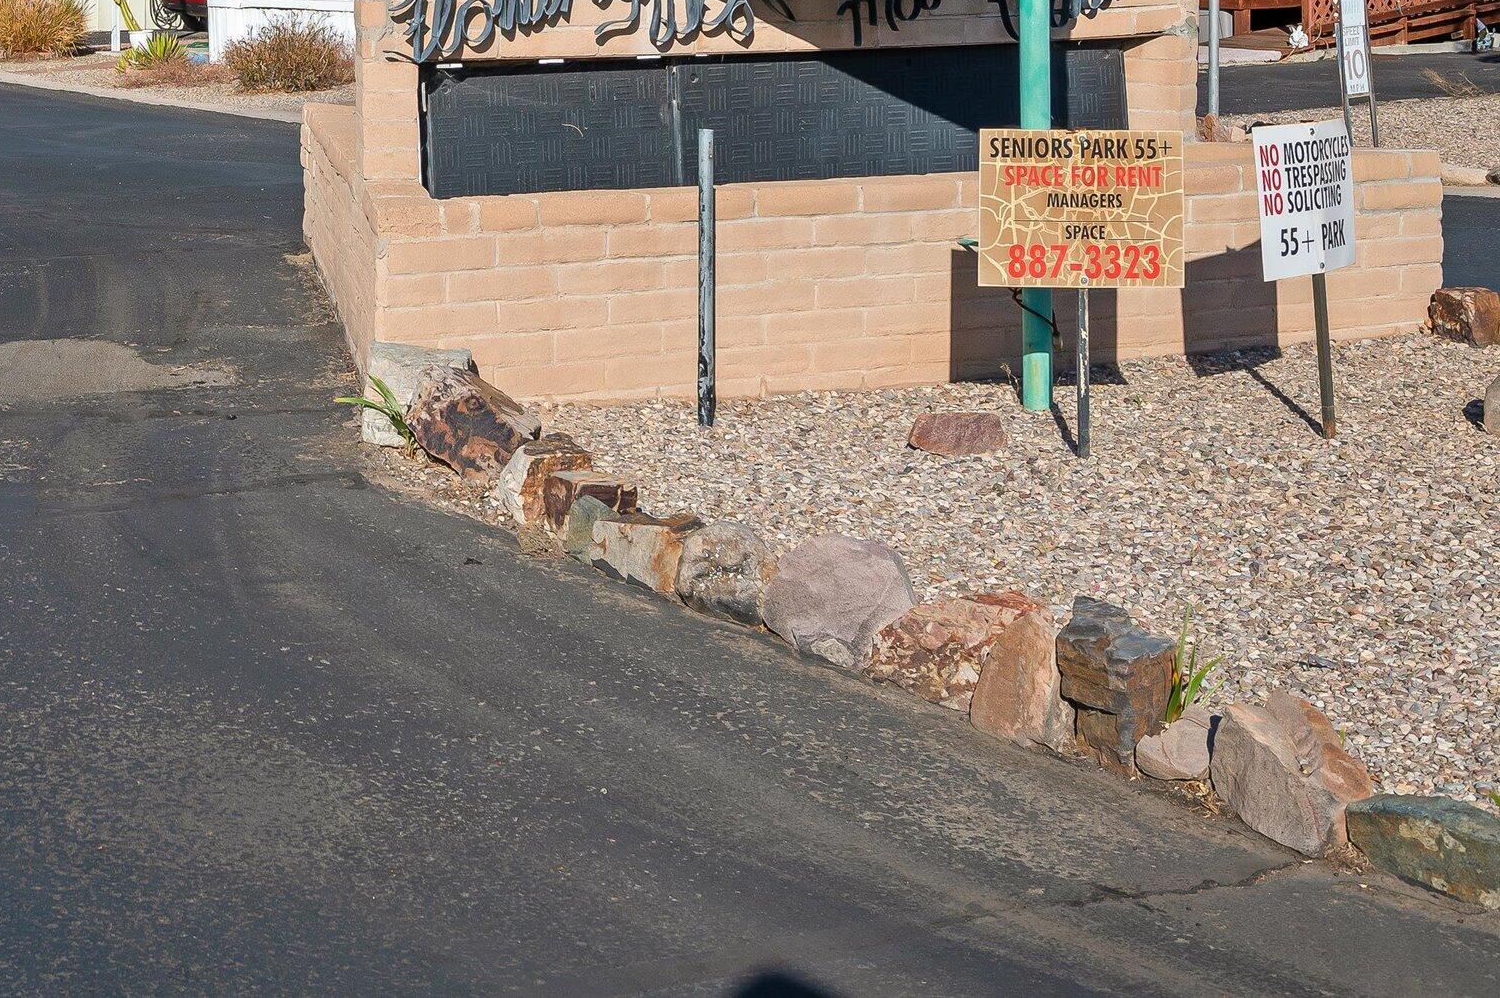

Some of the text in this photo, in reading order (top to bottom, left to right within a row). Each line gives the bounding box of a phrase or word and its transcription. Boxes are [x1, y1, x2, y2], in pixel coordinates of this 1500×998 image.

[1344, 49, 1365, 80] 10
[989, 137, 1173, 160] SENIORS PARK 55+
[1259, 135, 1349, 167] NO MOTORCYCLES
[1004, 165, 1162, 187] SPACE FOR RENT
[1262, 159, 1347, 192] NO TRESPASSING
[1047, 193, 1123, 208] MANAGERS
[1264, 184, 1342, 216] NO SOLICITING
[1065, 225, 1106, 240] SPACE
[1280, 218, 1346, 257] 55+ PARK
[1007, 244, 1161, 280] 887-3323
